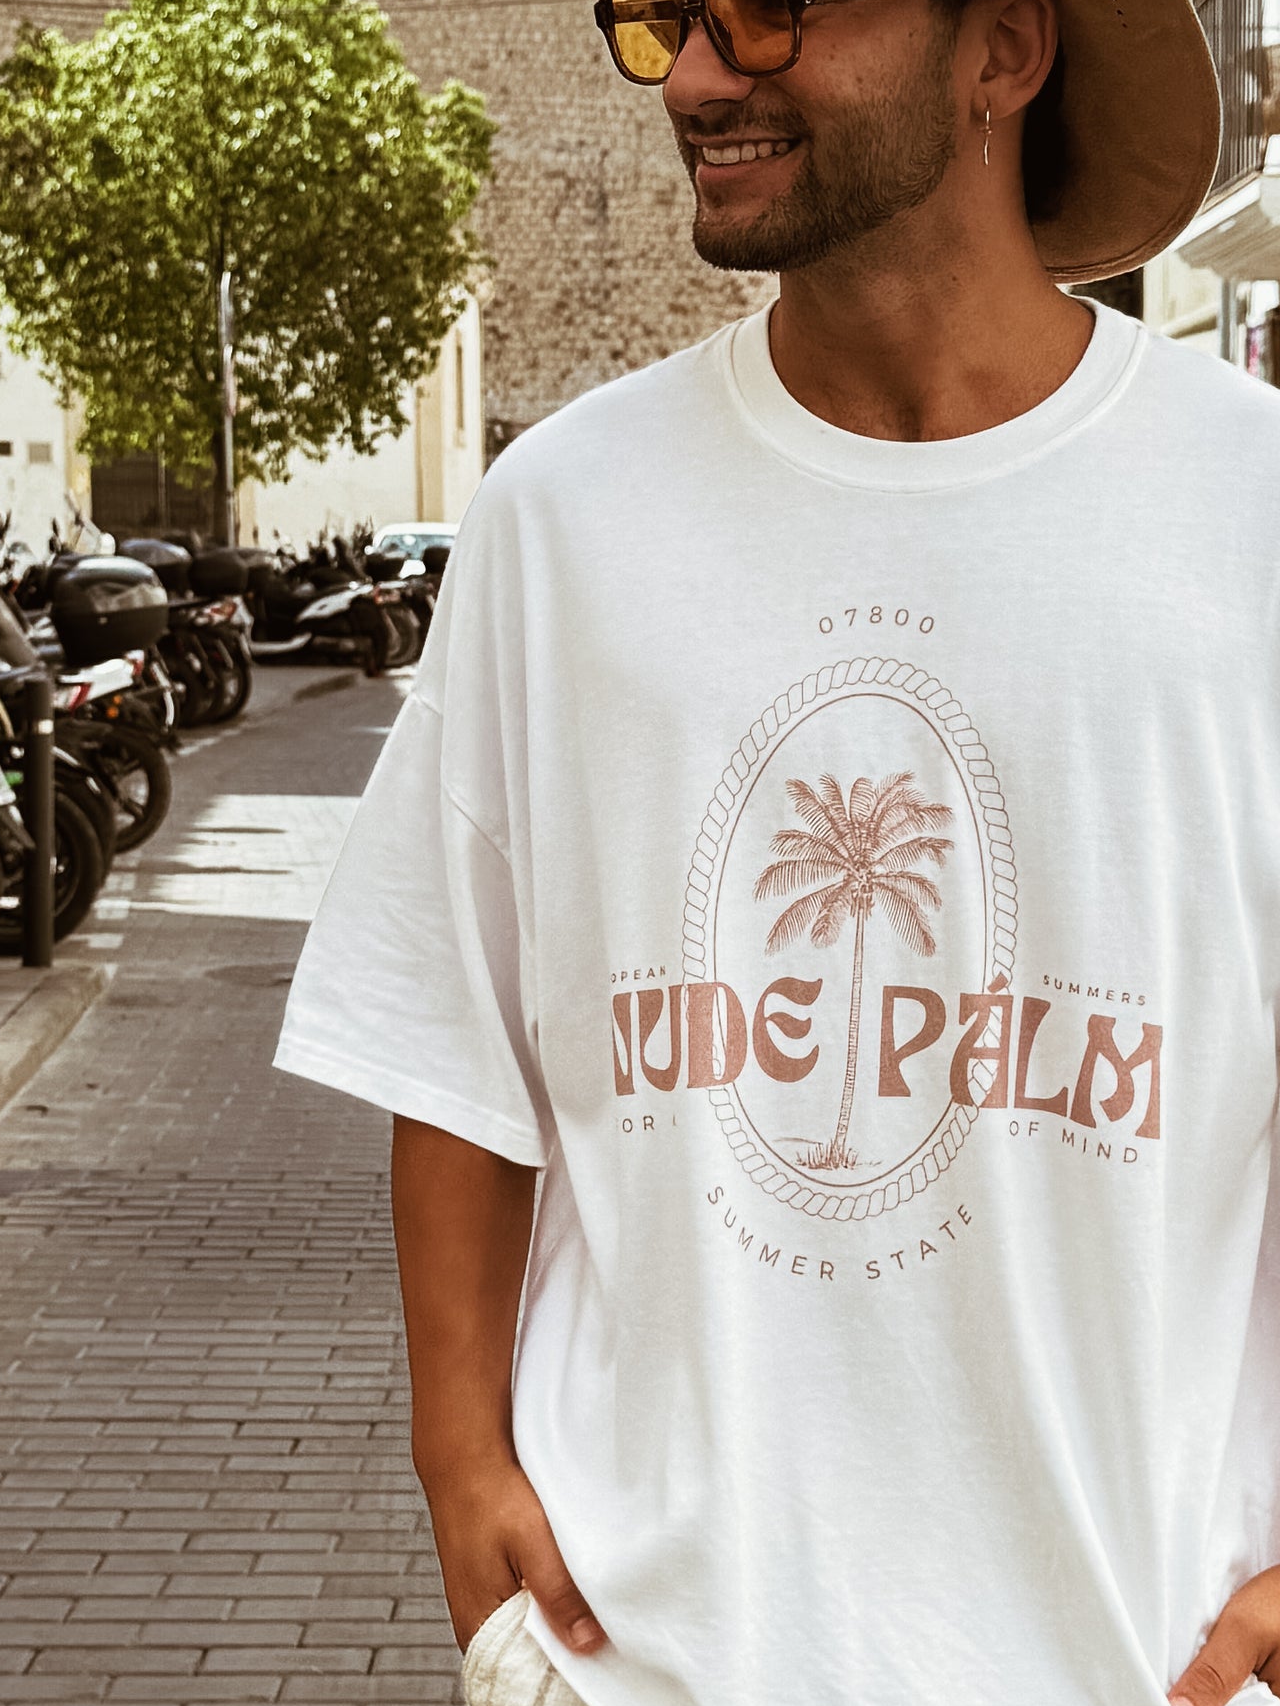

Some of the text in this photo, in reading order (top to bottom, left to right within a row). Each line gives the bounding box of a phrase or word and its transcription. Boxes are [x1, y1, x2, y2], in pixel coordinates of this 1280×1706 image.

[818, 605, 935, 635] 07800
[610, 964, 1147, 1006] OPEAN SUMMERS
[616, 1114, 656, 1134] OR
[1008, 1119, 1040, 1137] OF
[1061, 1127, 1139, 1164] MIND
[706, 1185, 973, 1282] SUMMER STATE
